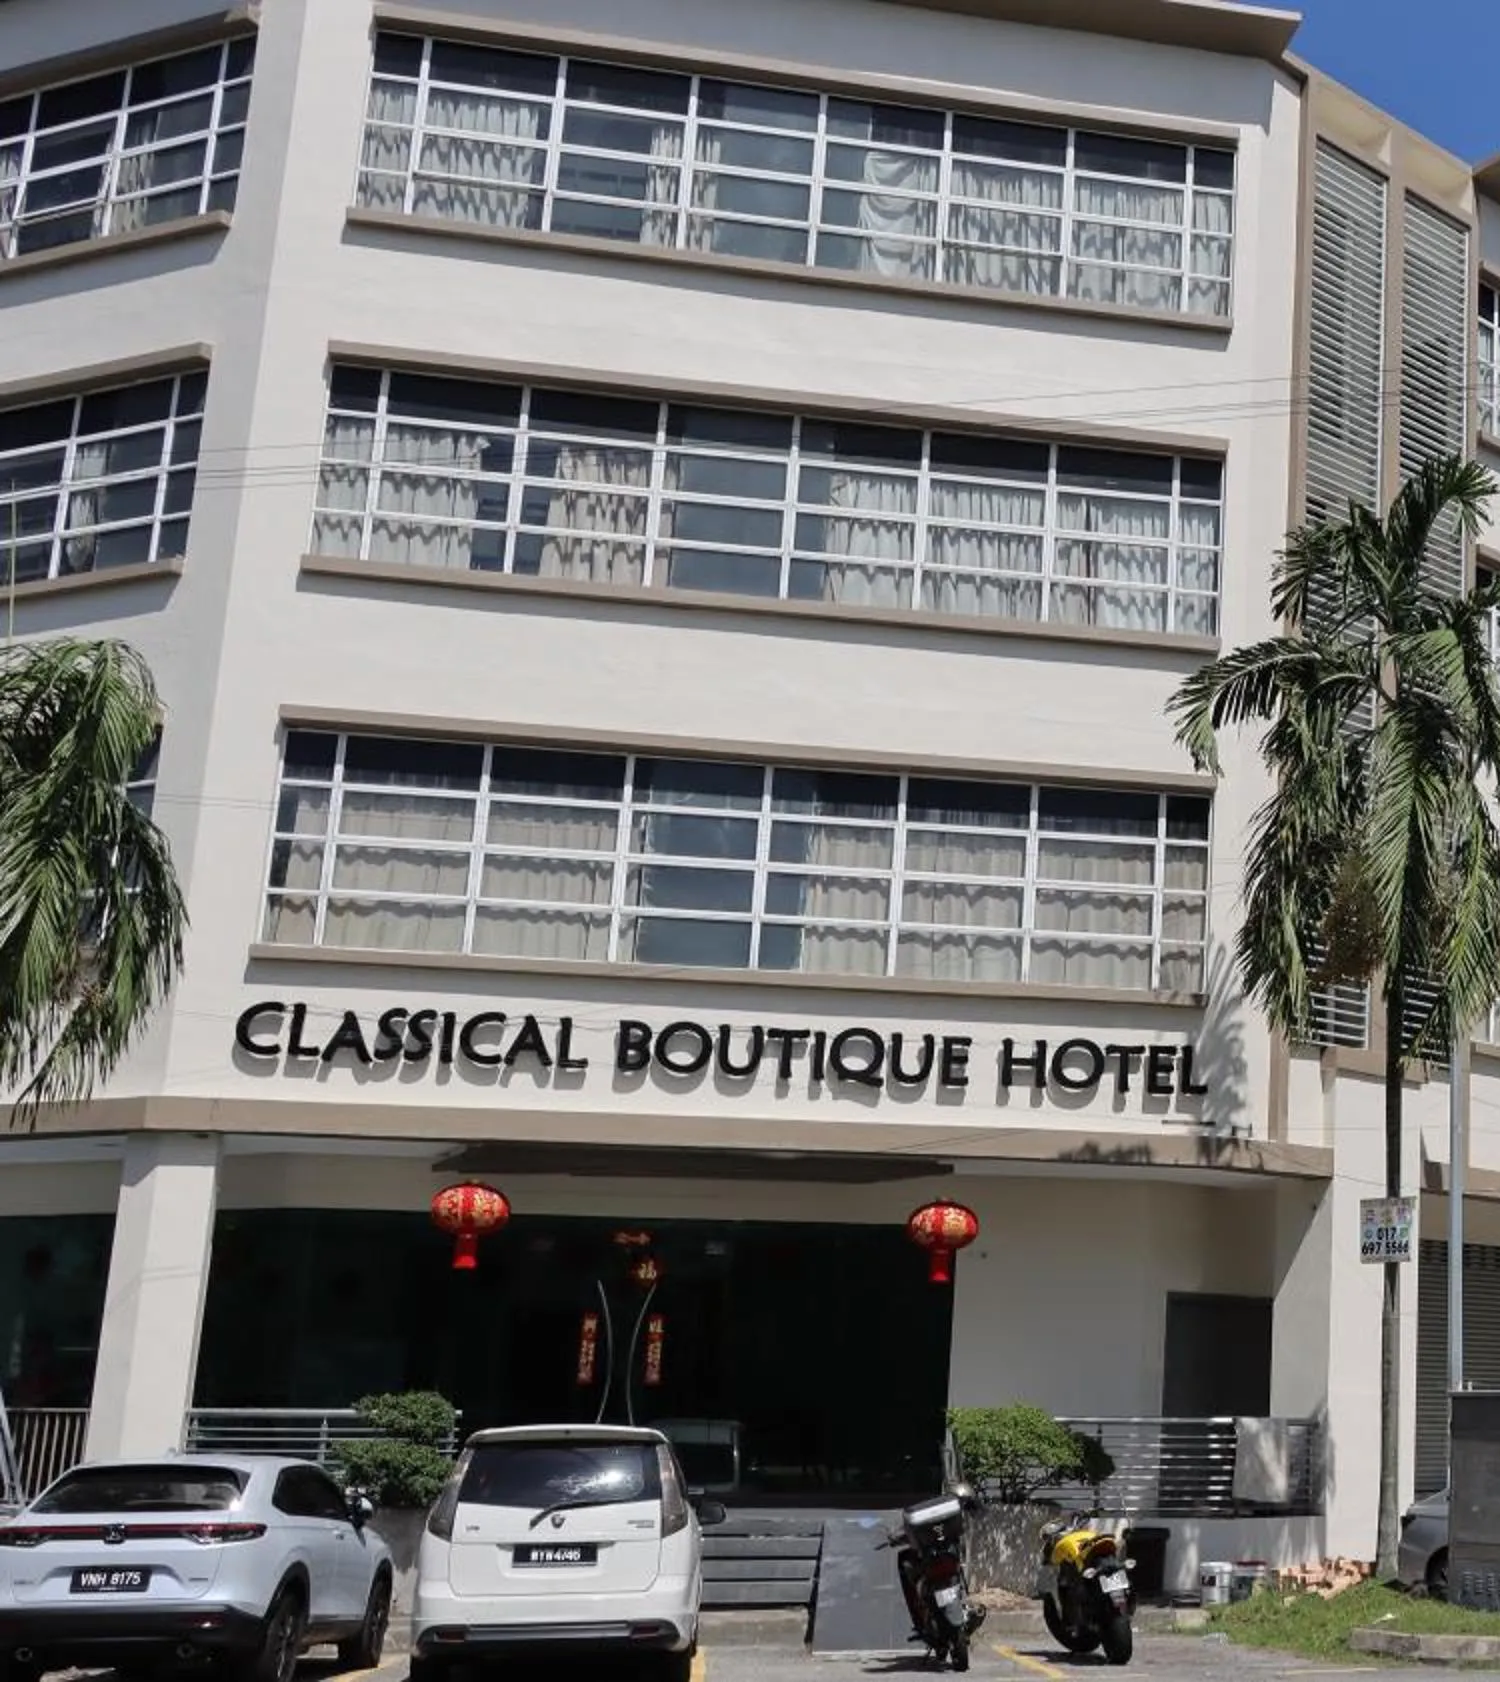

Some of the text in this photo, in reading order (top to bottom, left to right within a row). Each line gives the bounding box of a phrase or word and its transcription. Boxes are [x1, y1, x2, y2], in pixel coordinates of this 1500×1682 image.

[235, 1000, 1209, 1096] CLASSICAL BOUTIQUE HOTEL
[1376, 1226, 1397, 1241] 017
[1361, 1240, 1382, 1256] 697
[80, 1571, 141, 1587] VNH 8175
